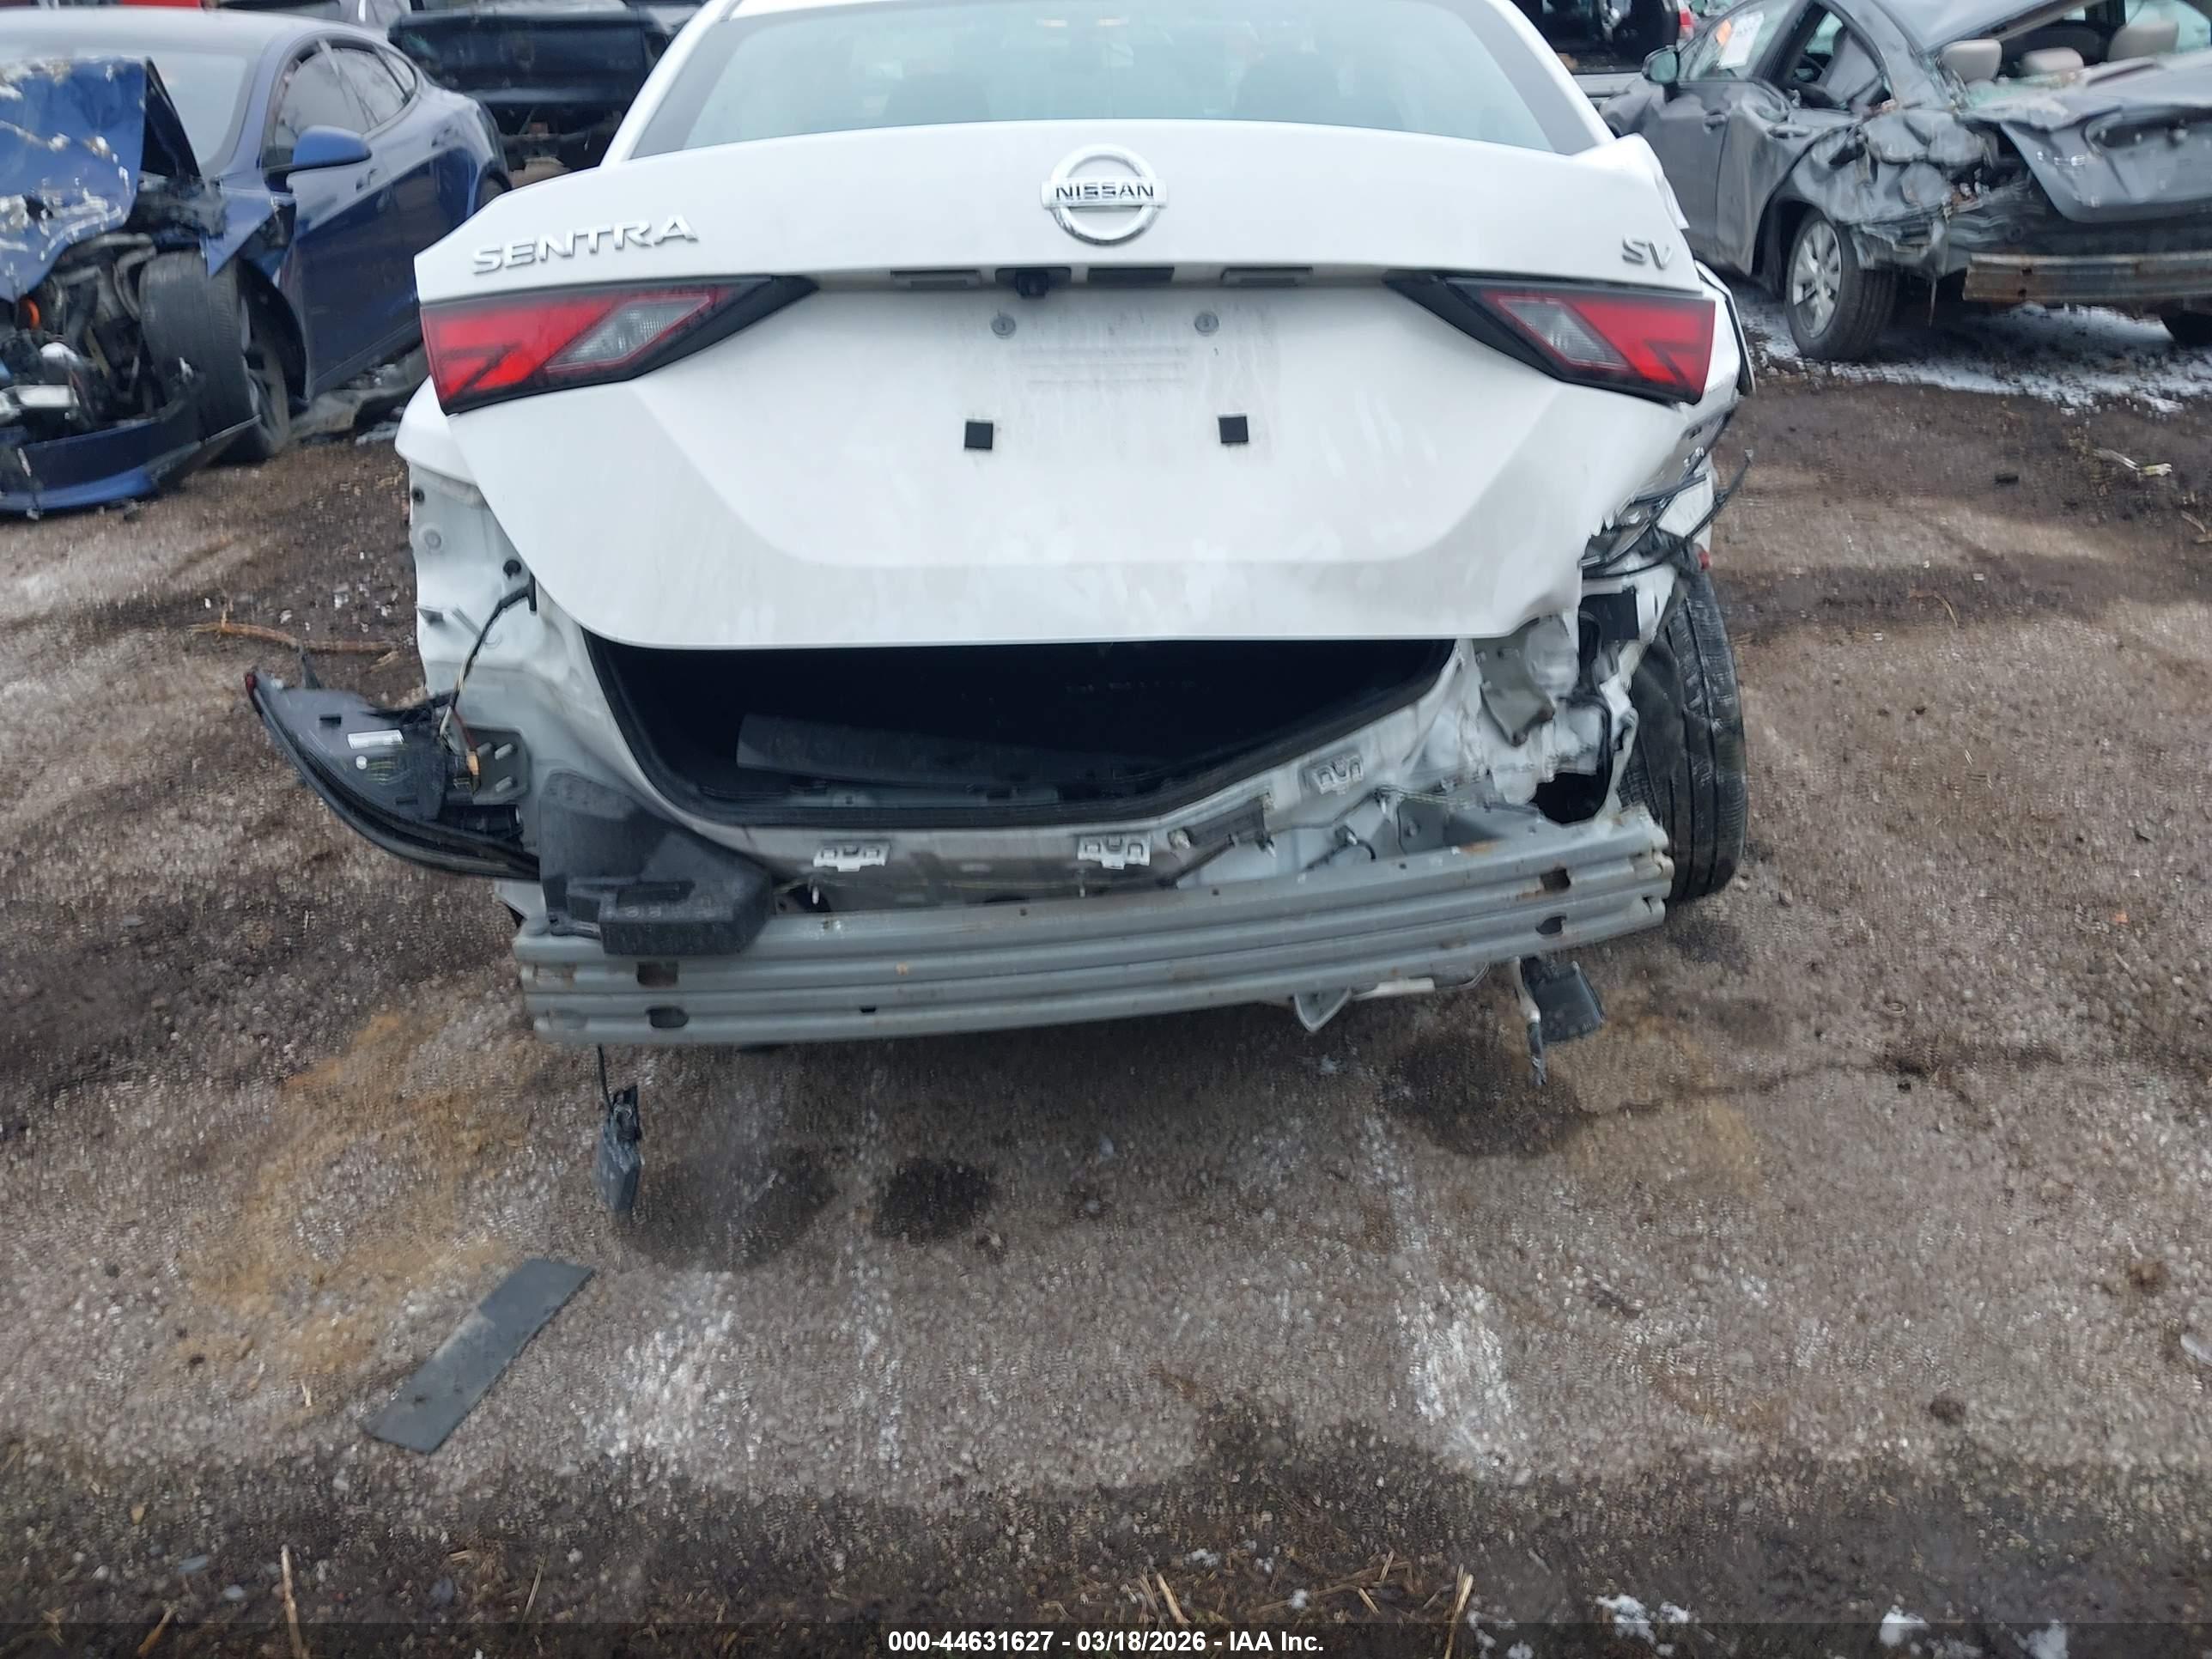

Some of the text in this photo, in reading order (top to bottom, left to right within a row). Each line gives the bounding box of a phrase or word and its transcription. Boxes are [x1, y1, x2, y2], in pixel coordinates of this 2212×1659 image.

[1055, 182, 1154, 200] NISSAN
[473, 215, 699, 274] SENTRA
[1621, 234, 1674, 270] SV
